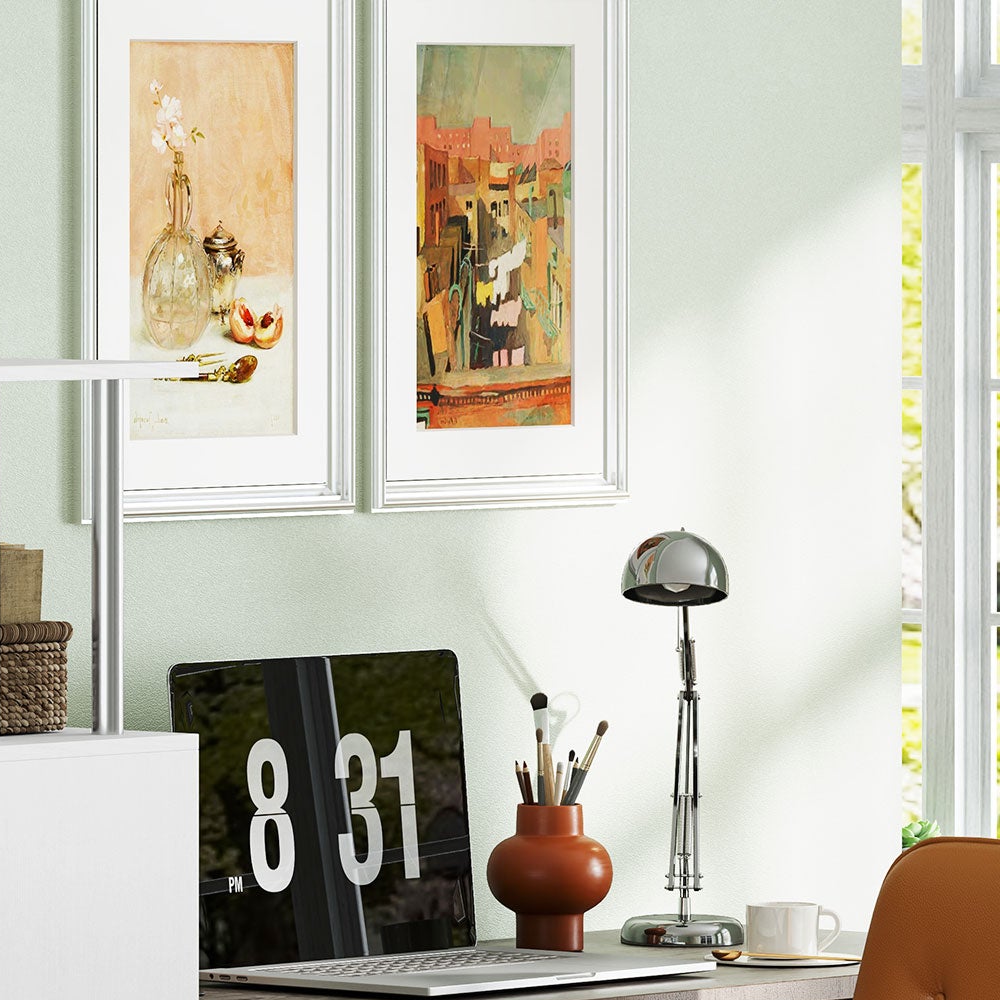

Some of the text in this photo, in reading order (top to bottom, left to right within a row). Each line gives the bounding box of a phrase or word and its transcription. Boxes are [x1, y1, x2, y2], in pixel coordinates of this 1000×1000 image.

[246, 729, 421, 893] 8 31
[228, 876, 244, 894] PM
